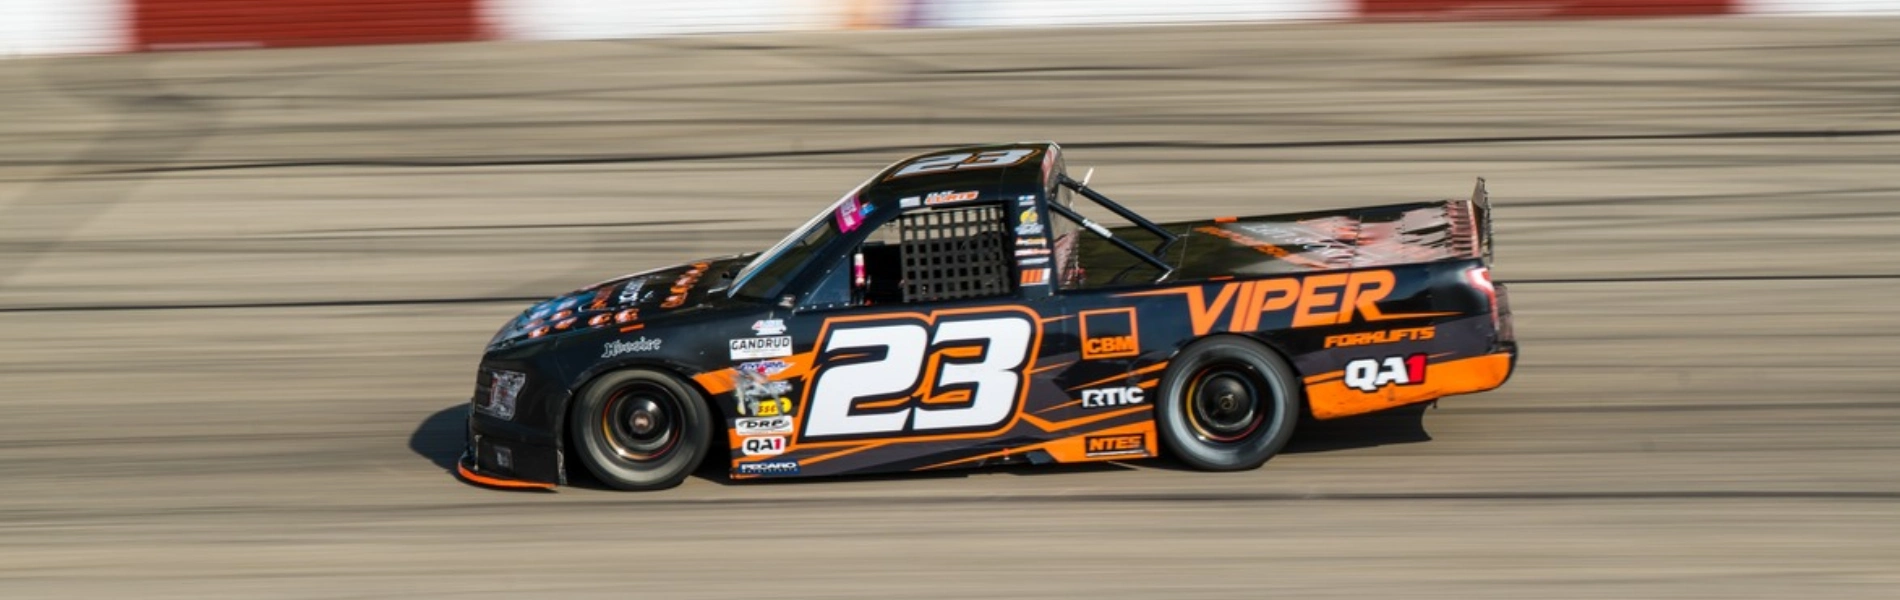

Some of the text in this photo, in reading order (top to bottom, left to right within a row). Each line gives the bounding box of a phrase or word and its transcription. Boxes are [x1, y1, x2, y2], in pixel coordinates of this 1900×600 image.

[889, 149, 1036, 170] 23
[1186, 269, 1396, 336] VIPER
[731, 337, 790, 350] GANDRUD
[1088, 336, 1133, 354] CBM
[1323, 326, 1436, 349] FORKLIFTS
[803, 317, 1033, 438] 23
[1344, 353, 1427, 391] QA1
[1081, 387, 1145, 408] RTIC
[746, 438, 781, 453] QA1
[1089, 435, 1142, 451] NTES
